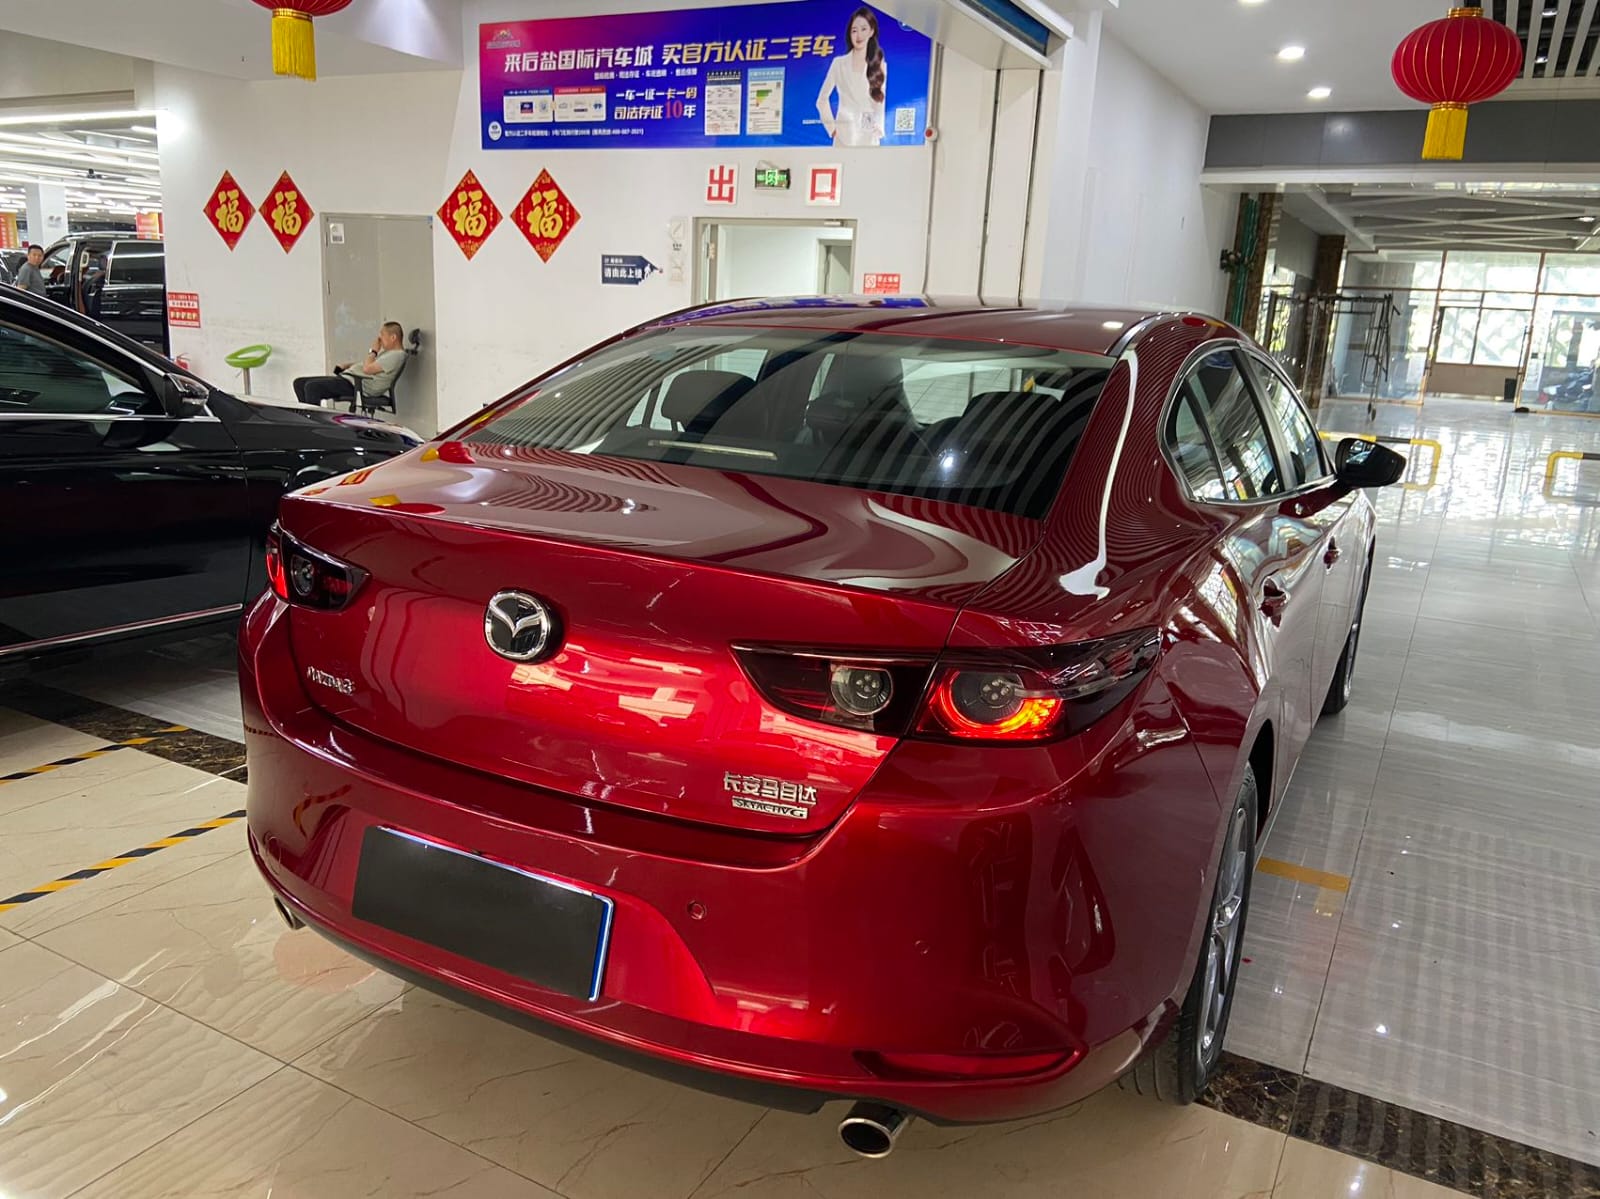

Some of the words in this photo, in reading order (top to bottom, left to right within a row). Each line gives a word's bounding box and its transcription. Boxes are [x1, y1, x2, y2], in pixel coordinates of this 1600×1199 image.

[504, 45, 653, 73] 来后盐国际汽车城
[662, 35, 836, 65] 买官方认证二手车
[614, 100, 697, 120] 司法存证10年
[616, 87, 698, 101] 一车一证一卡一码
[707, 165, 735, 203] 出
[811, 168, 838, 201] 口
[215, 189, 245, 233] 福
[271, 190, 302, 236] 福
[453, 190, 487, 238] 福
[526, 189, 563, 239] 福
[723, 771, 817, 805] 长安马自达
